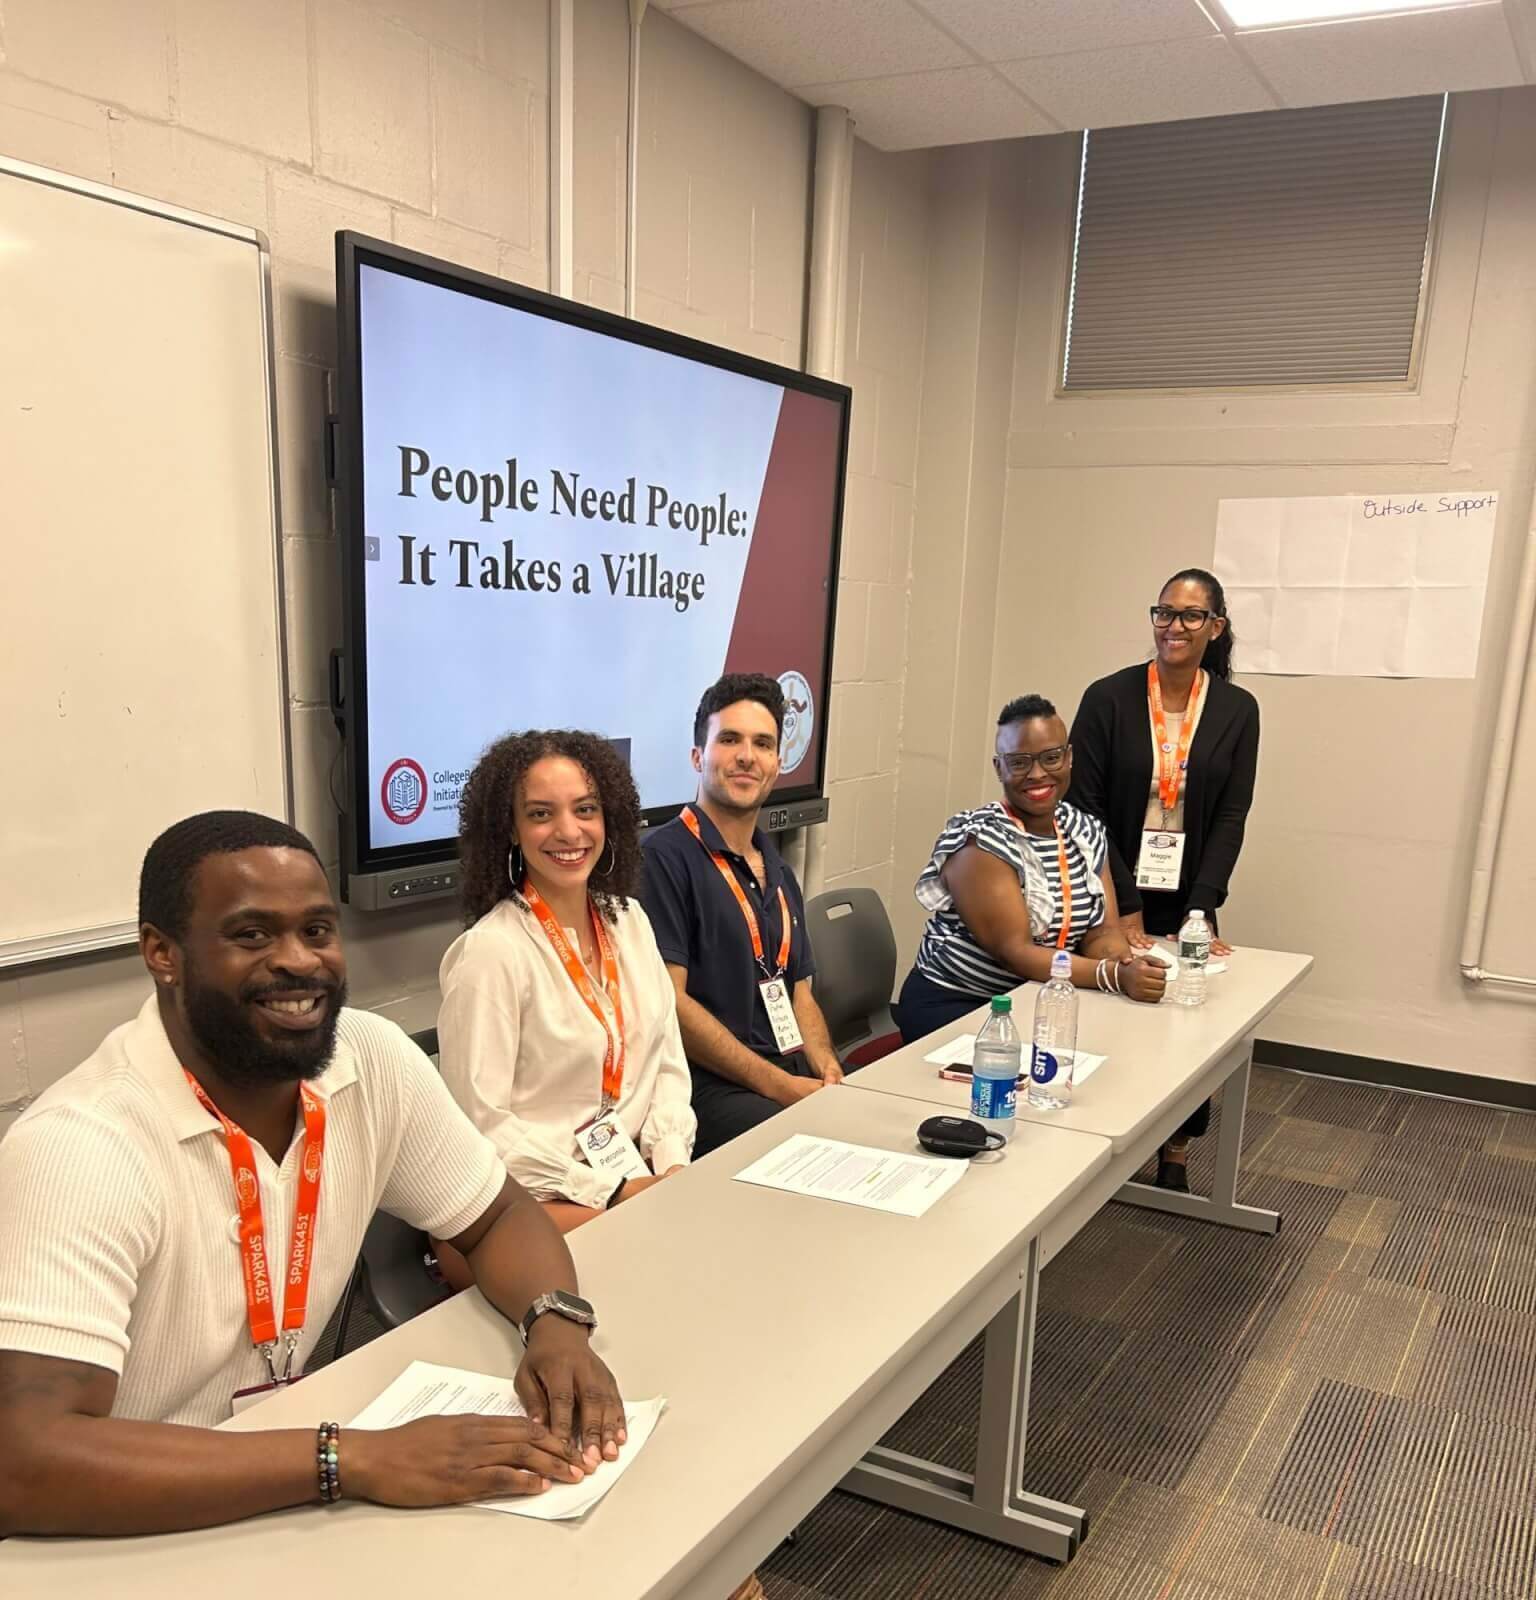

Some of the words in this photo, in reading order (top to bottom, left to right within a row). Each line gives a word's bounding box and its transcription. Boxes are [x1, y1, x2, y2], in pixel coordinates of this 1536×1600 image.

[398, 446, 538, 522] People
[551, 470, 635, 523] Need
[647, 486, 748, 546] People:
[1363, 498, 1427, 519] Outside
[1437, 495, 1497, 518] Support
[398, 536, 436, 585] It
[450, 540, 560, 592] Takes
[573, 564, 591, 594] a
[601, 553, 704, 612] Village
[433, 769, 470, 785] CollegeB
[433, 786, 464, 801] Initiati
[249, 1234, 271, 1304] SPARK451
[289, 1213, 309, 1286] SPARK451
